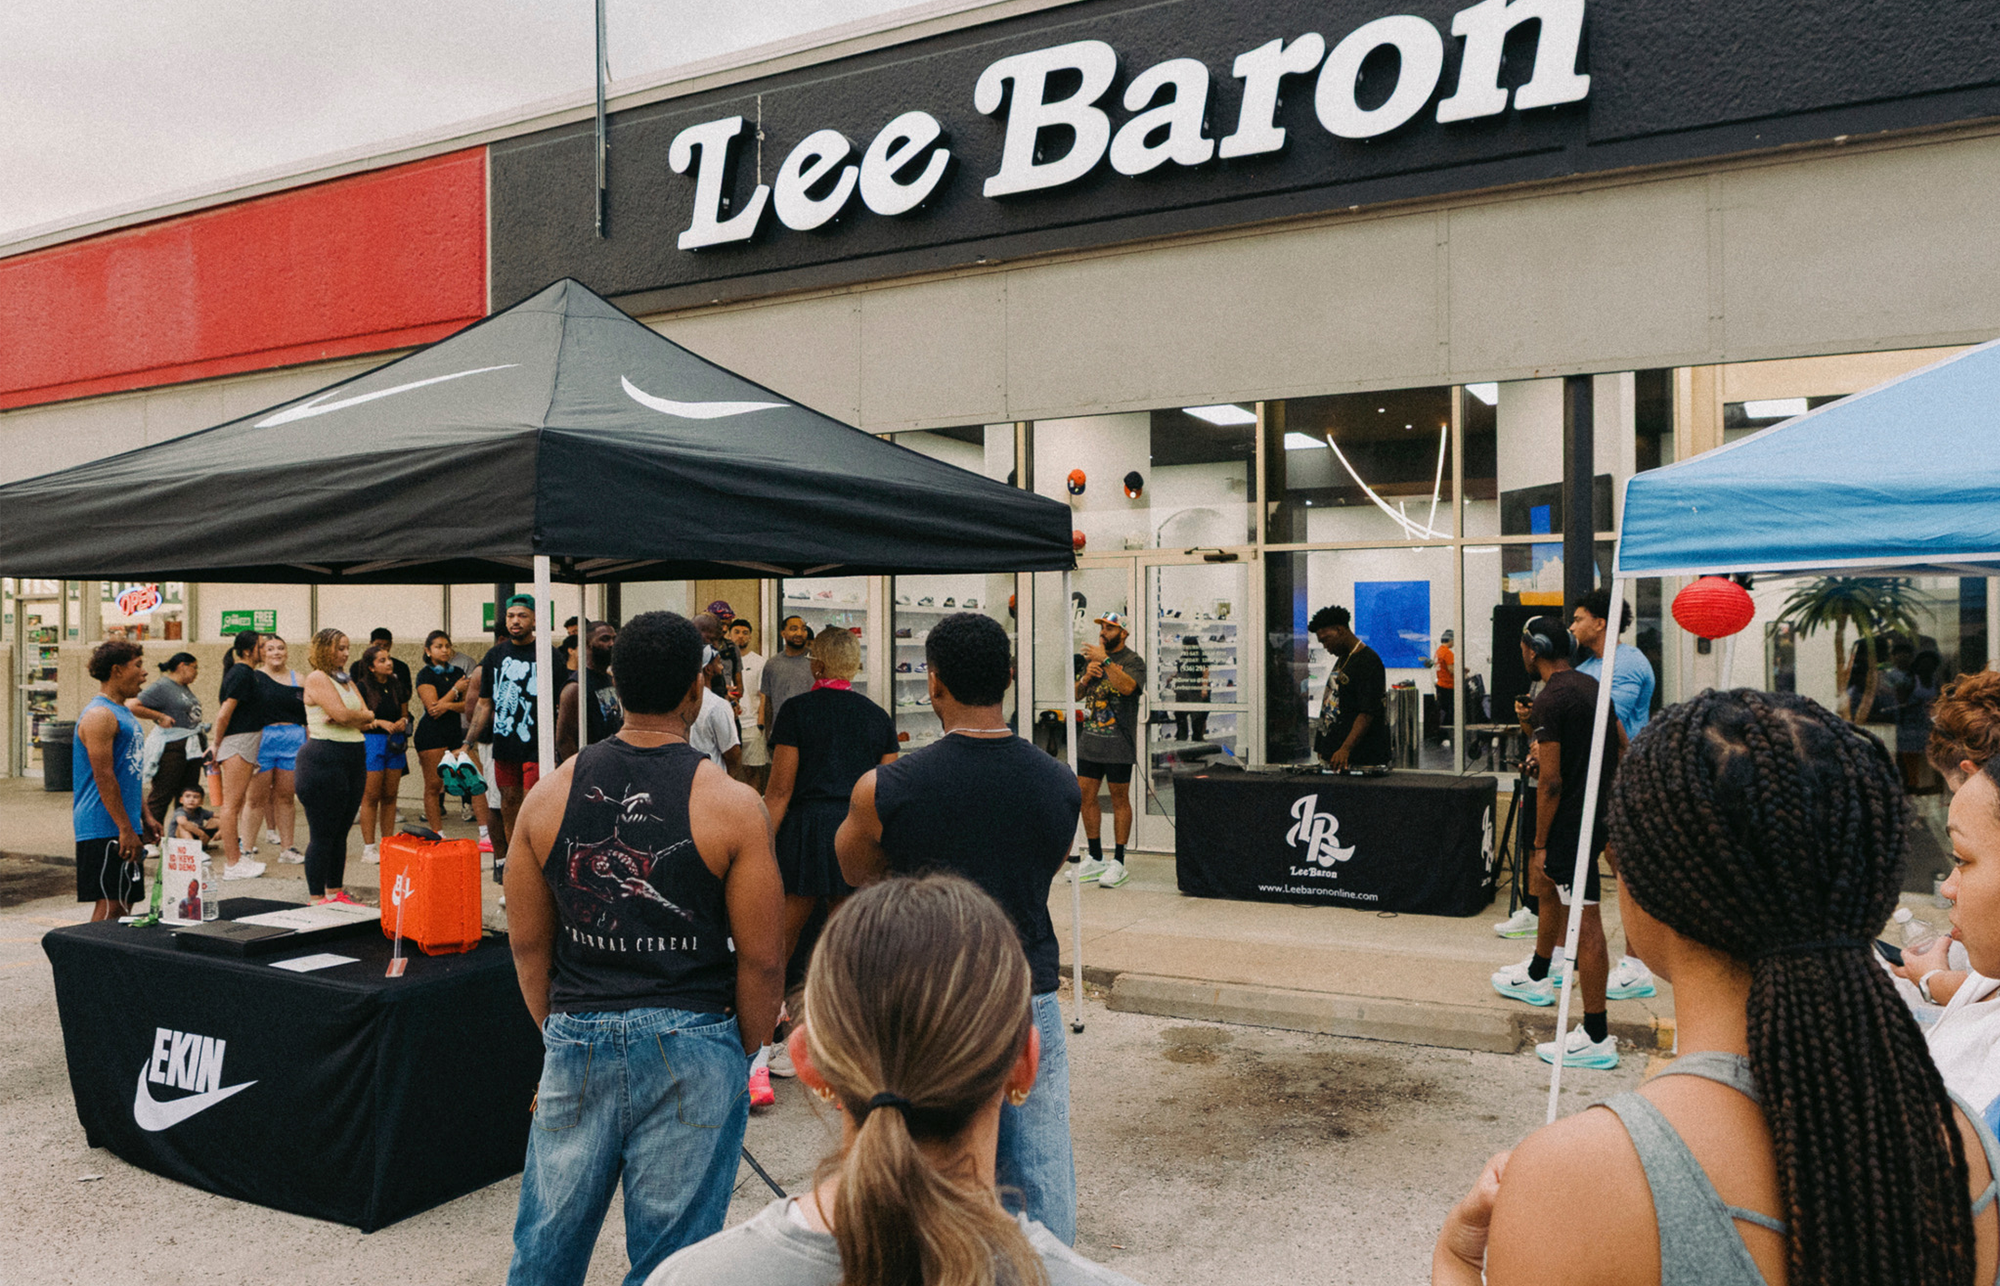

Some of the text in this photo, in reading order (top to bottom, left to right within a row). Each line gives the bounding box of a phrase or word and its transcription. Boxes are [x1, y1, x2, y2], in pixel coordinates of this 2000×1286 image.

[668, 0, 1591, 251] Lee Baron
[119, 583, 158, 617] OPEN
[177, 846, 187, 854] NO
[168, 862, 196, 872] NO DEMO
[179, 855, 195, 863] KEYS
[1258, 884, 1378, 901] www.Leebarononline.com
[636, 936, 697, 952] CEREAL
[148, 1027, 226, 1094] EKIN
